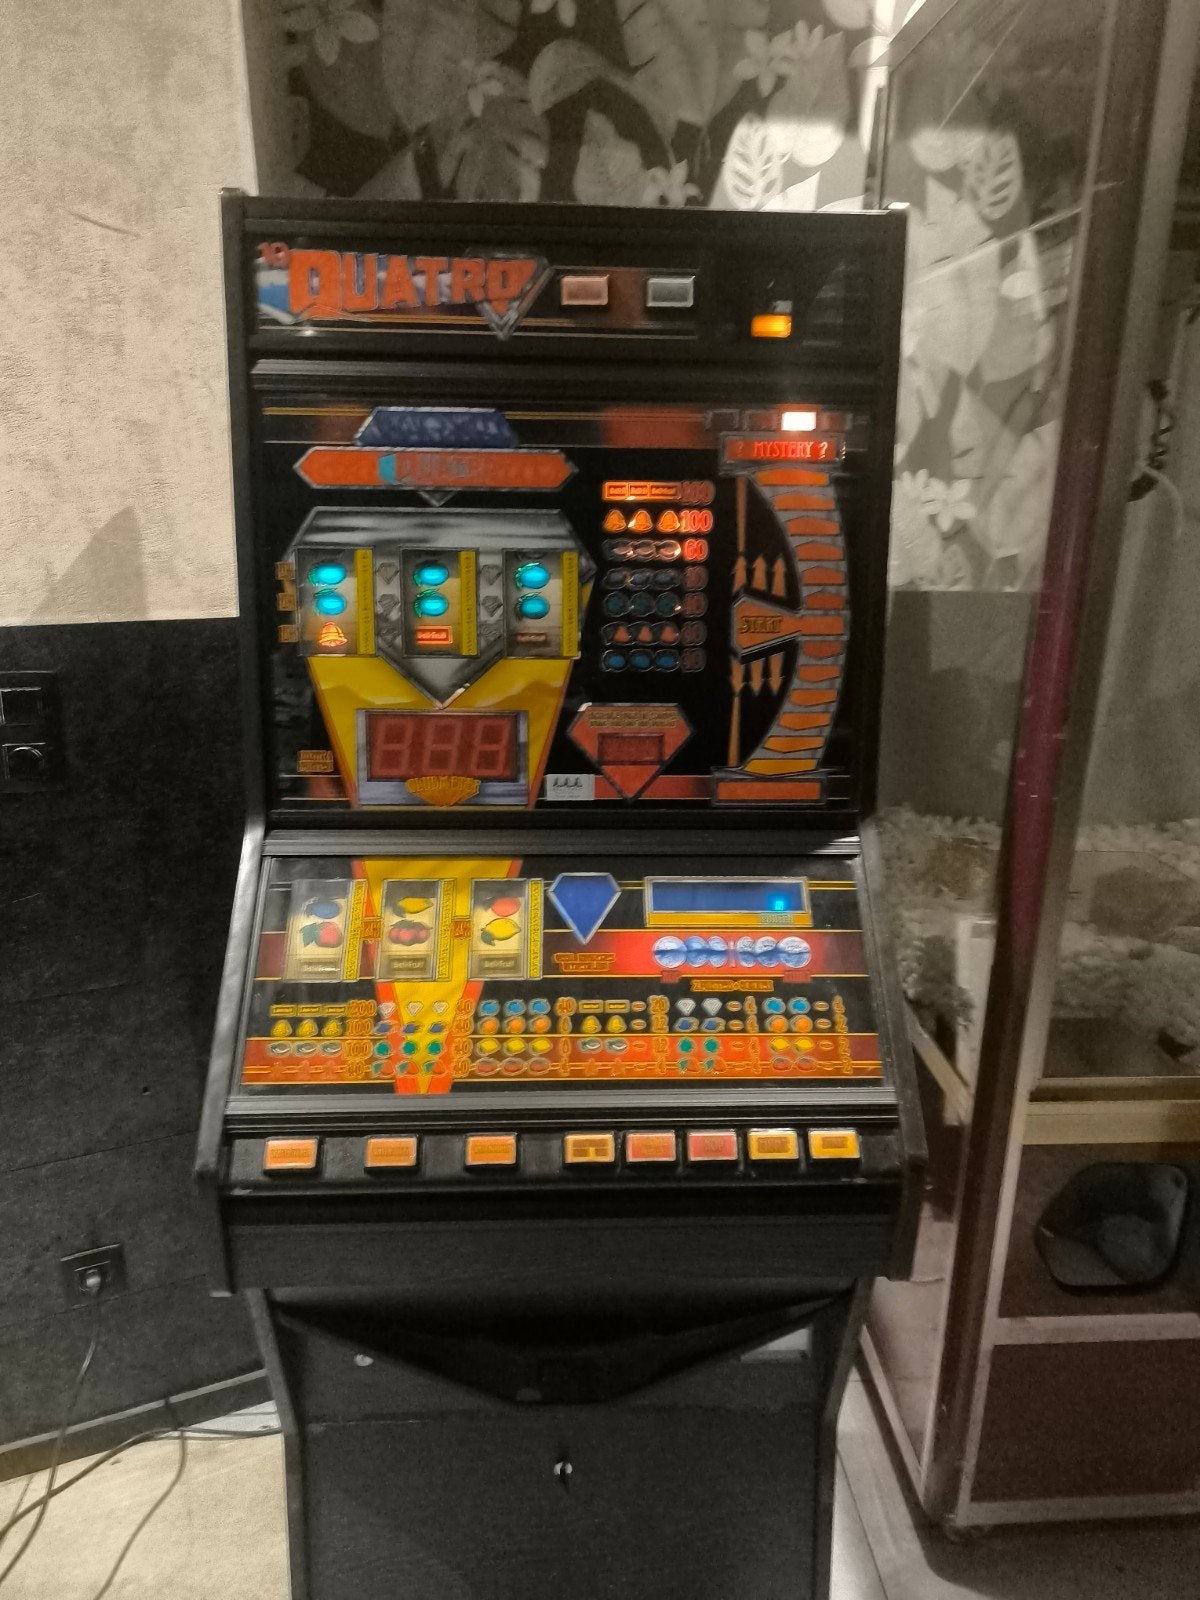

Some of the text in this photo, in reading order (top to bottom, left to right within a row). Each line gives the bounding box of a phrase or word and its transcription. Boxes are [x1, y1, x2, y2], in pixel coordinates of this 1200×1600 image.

[288, 249, 537, 320] QUATRO
[753, 441, 813, 458] MYSTERY
[680, 510, 713, 533] 100
